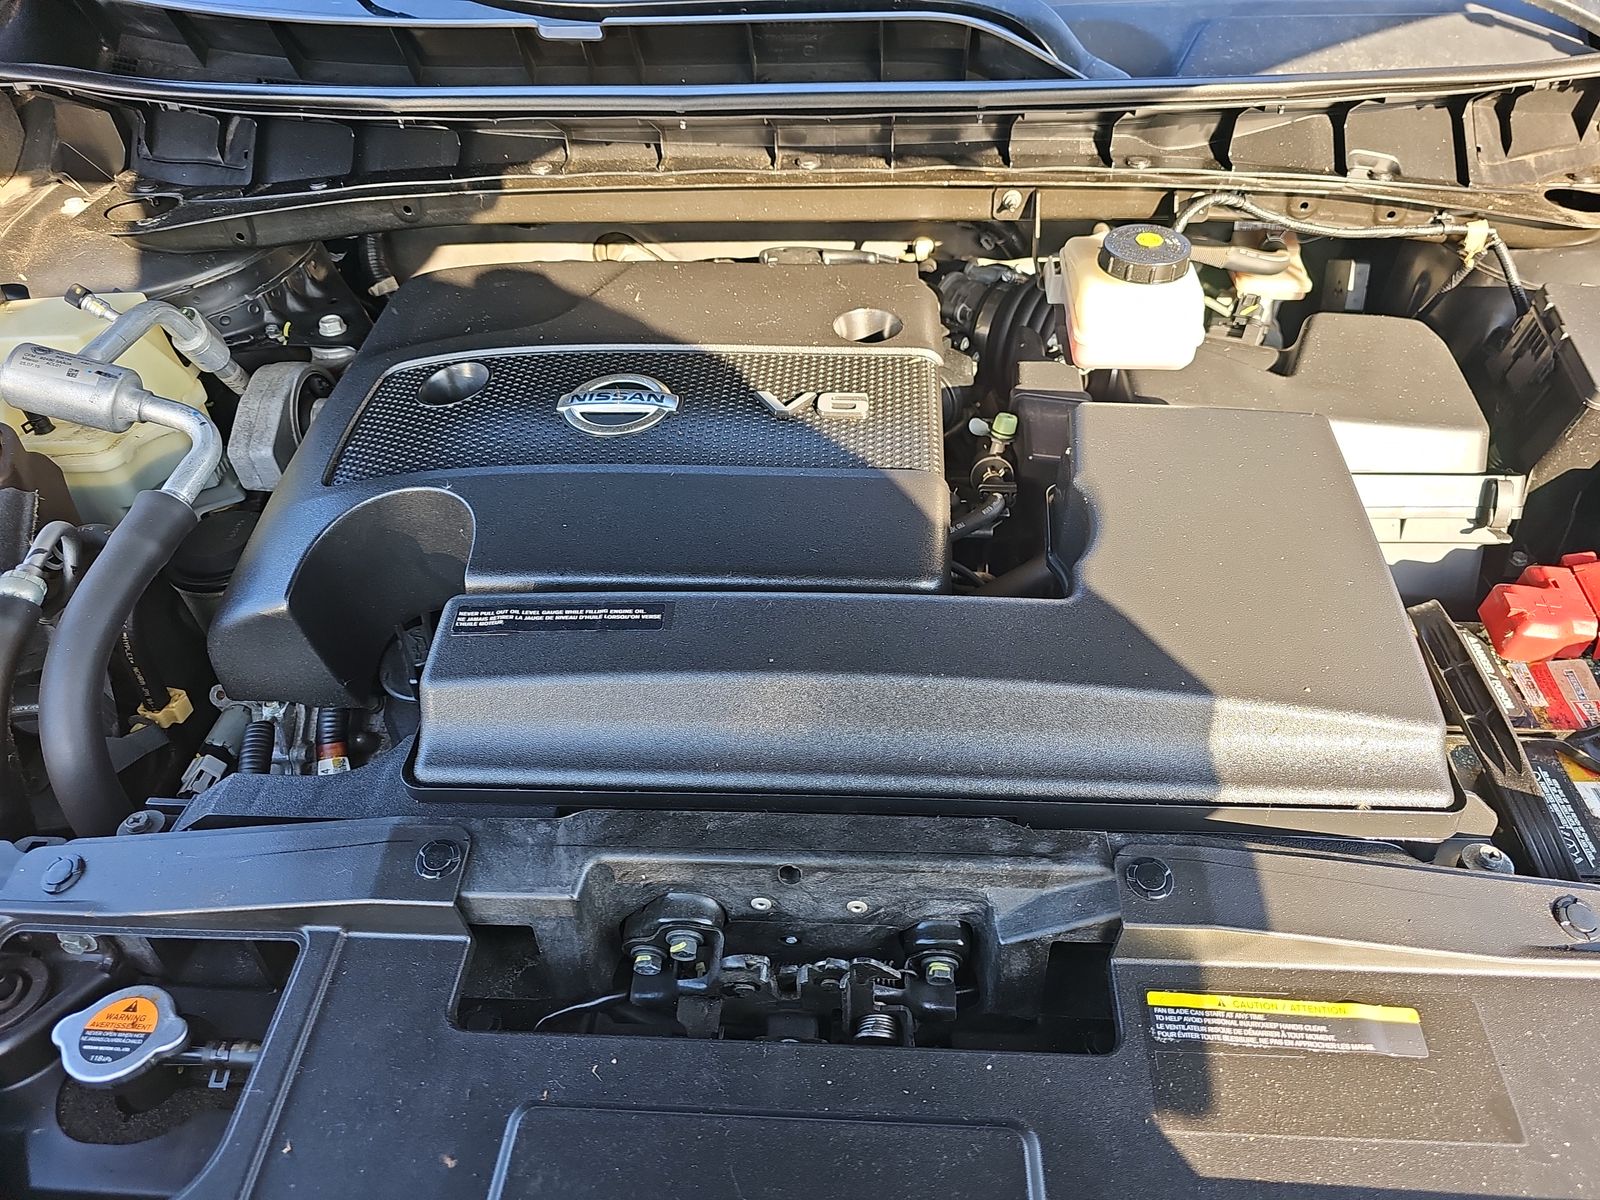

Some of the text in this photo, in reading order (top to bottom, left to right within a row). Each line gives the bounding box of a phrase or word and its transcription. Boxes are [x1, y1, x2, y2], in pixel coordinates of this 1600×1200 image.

[570, 392, 665, 403] NISSAN
[753, 391, 869, 420] V6
[1471, 641, 1495, 674] DANGER
[1491, 679, 1515, 709] POISON
[1232, 1000, 1278, 1011] CAUTION
[1290, 1004, 1346, 1014] ATTENTION
[105, 1012, 147, 1022] WARNING
[89, 1021, 153, 1031] AVERTISSEMENT
[1204, 1018, 1237, 1026] PERSONAL
[1280, 1023, 1303, 1031] HANDS
[1165, 1024, 1207, 1032] VENTILATEUR
[1207, 1026, 1233, 1034] RISQUE
[1287, 1031, 1304, 1040] TOUT
[1177, 1030, 1200, 1039] ÉVITER
[1259, 1037, 1269, 1045] NE
[1270, 1038, 1283, 1046] PAS
[1284, 1039, 1295, 1047] EN
[1295, 1040, 1337, 1049] APPROCHER
[1337, 1042, 1350, 1050] LES
